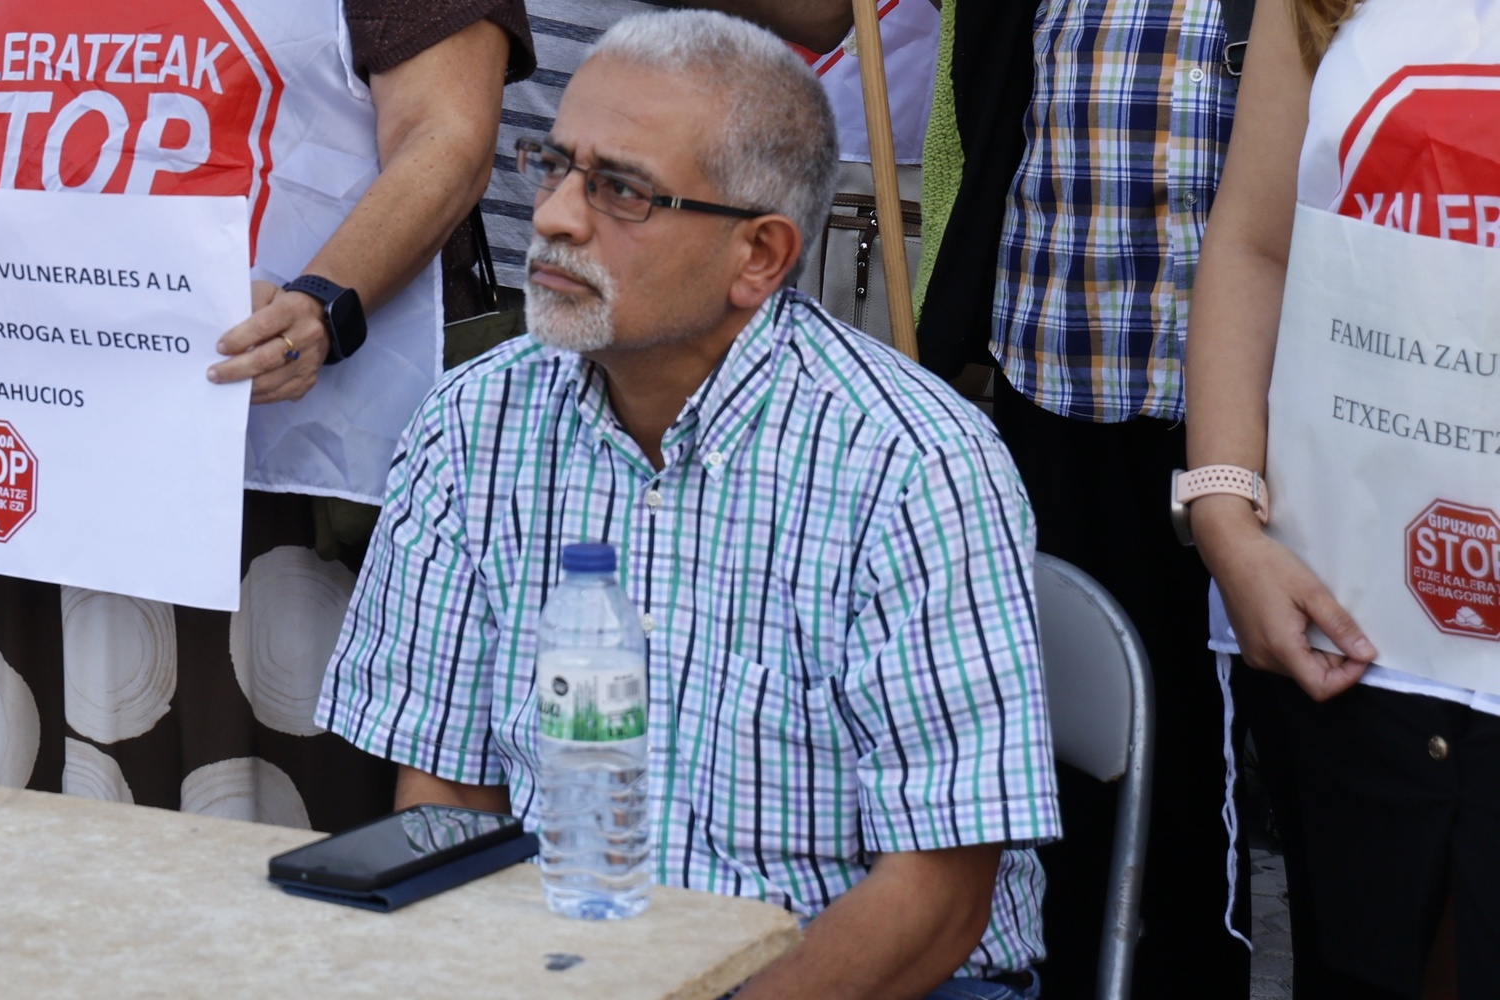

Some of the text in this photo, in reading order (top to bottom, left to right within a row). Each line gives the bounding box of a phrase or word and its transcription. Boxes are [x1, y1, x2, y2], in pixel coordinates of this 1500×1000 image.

[146, 272, 161, 290] A
[166, 273, 192, 292] LA
[71, 328, 92, 346] EL
[97, 330, 191, 354] DECRETO
[1329, 318, 1500, 377] FAMILIA ZAU
[1427, 512, 1498, 542] GIPUZKOA
[1413, 566, 1441, 584] ETXE
[1417, 580, 1495, 607] GEHIAGORIK
